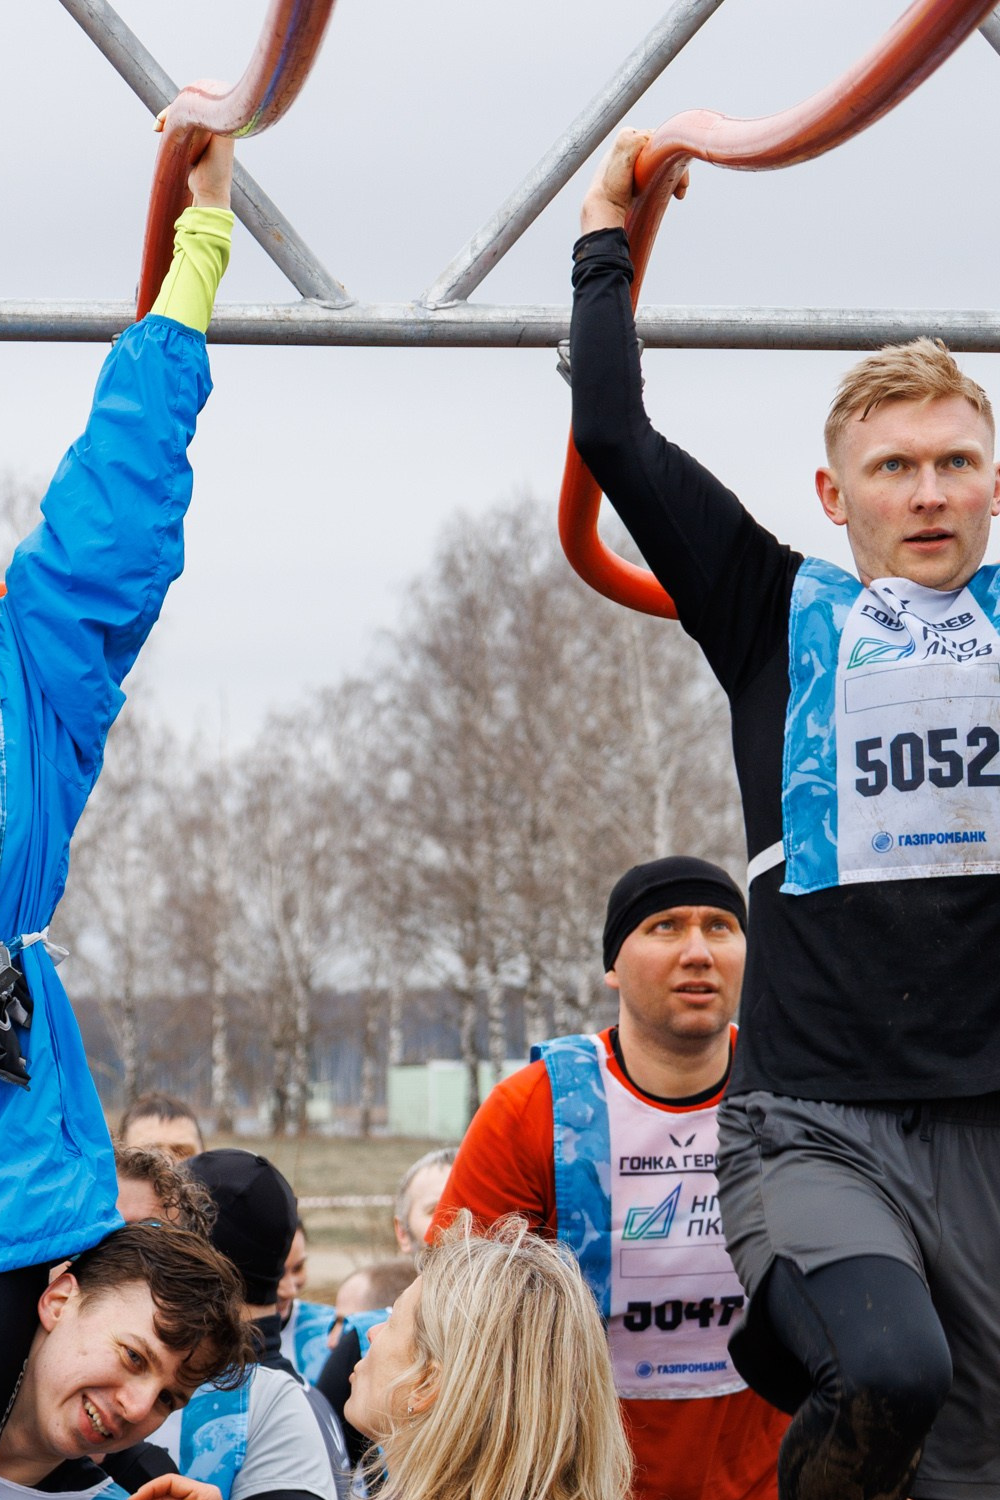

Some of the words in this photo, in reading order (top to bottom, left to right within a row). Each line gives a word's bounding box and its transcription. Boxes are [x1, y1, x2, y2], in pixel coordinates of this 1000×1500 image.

[855, 726, 1000, 798] 5052
[898, 831, 987, 847] ГАЗПРОМБАНК
[620, 1156, 677, 1170] ГОНКА
[683, 1154, 719, 1168] ГЕР
[691, 1195, 719, 1213] НП
[657, 1361, 727, 1375] ГАЗПРОМБАНК
